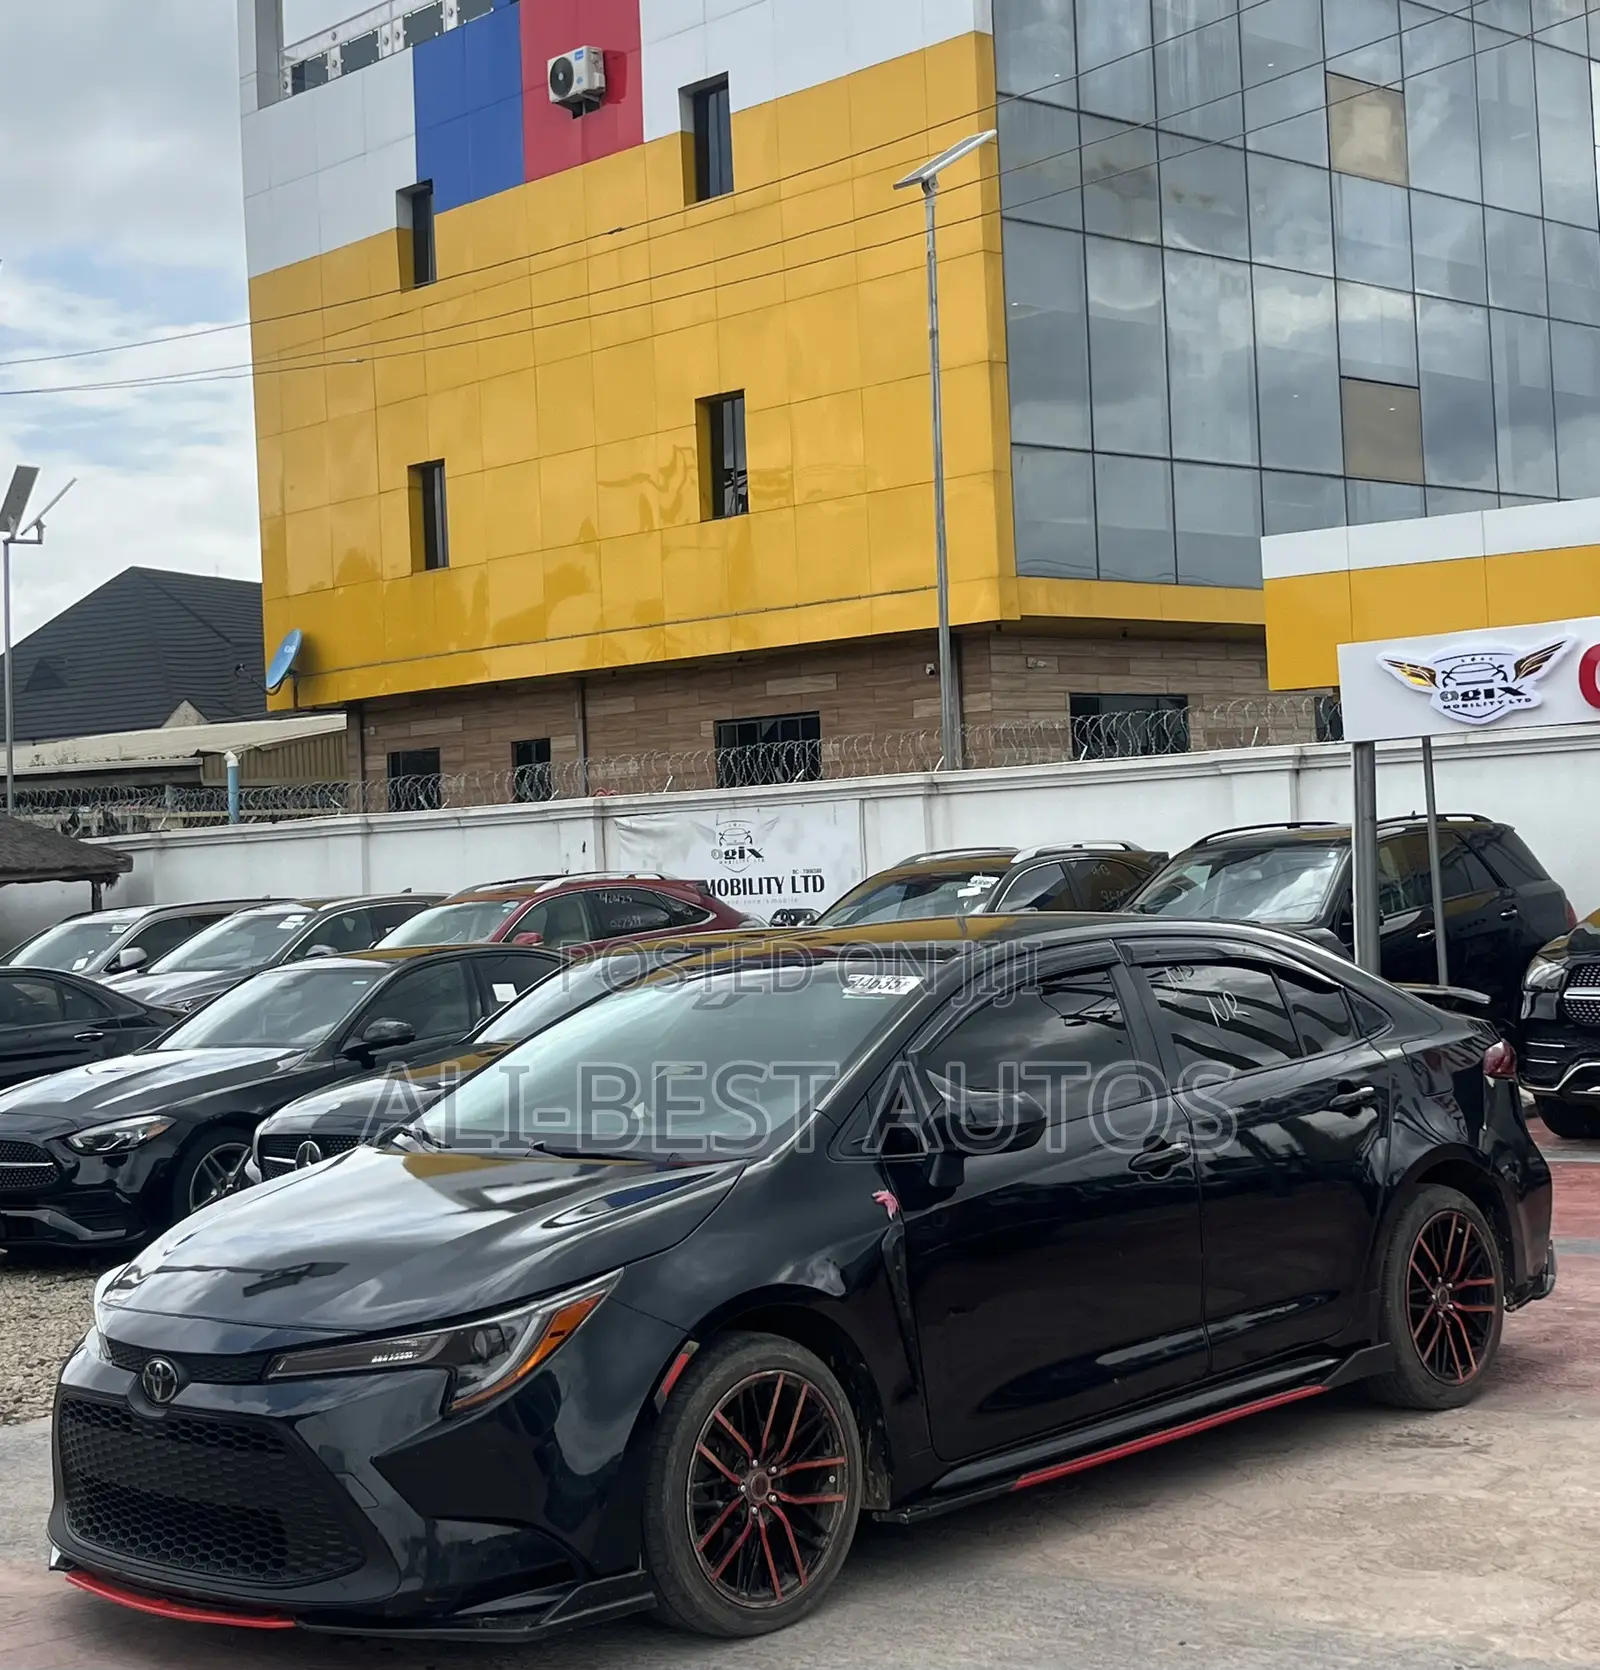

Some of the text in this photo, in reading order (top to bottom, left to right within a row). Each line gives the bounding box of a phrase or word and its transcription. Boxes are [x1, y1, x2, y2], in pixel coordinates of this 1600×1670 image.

[1443, 700, 1504, 709] MOBILITY
[706, 874, 825, 897] MOBILITY LTD
